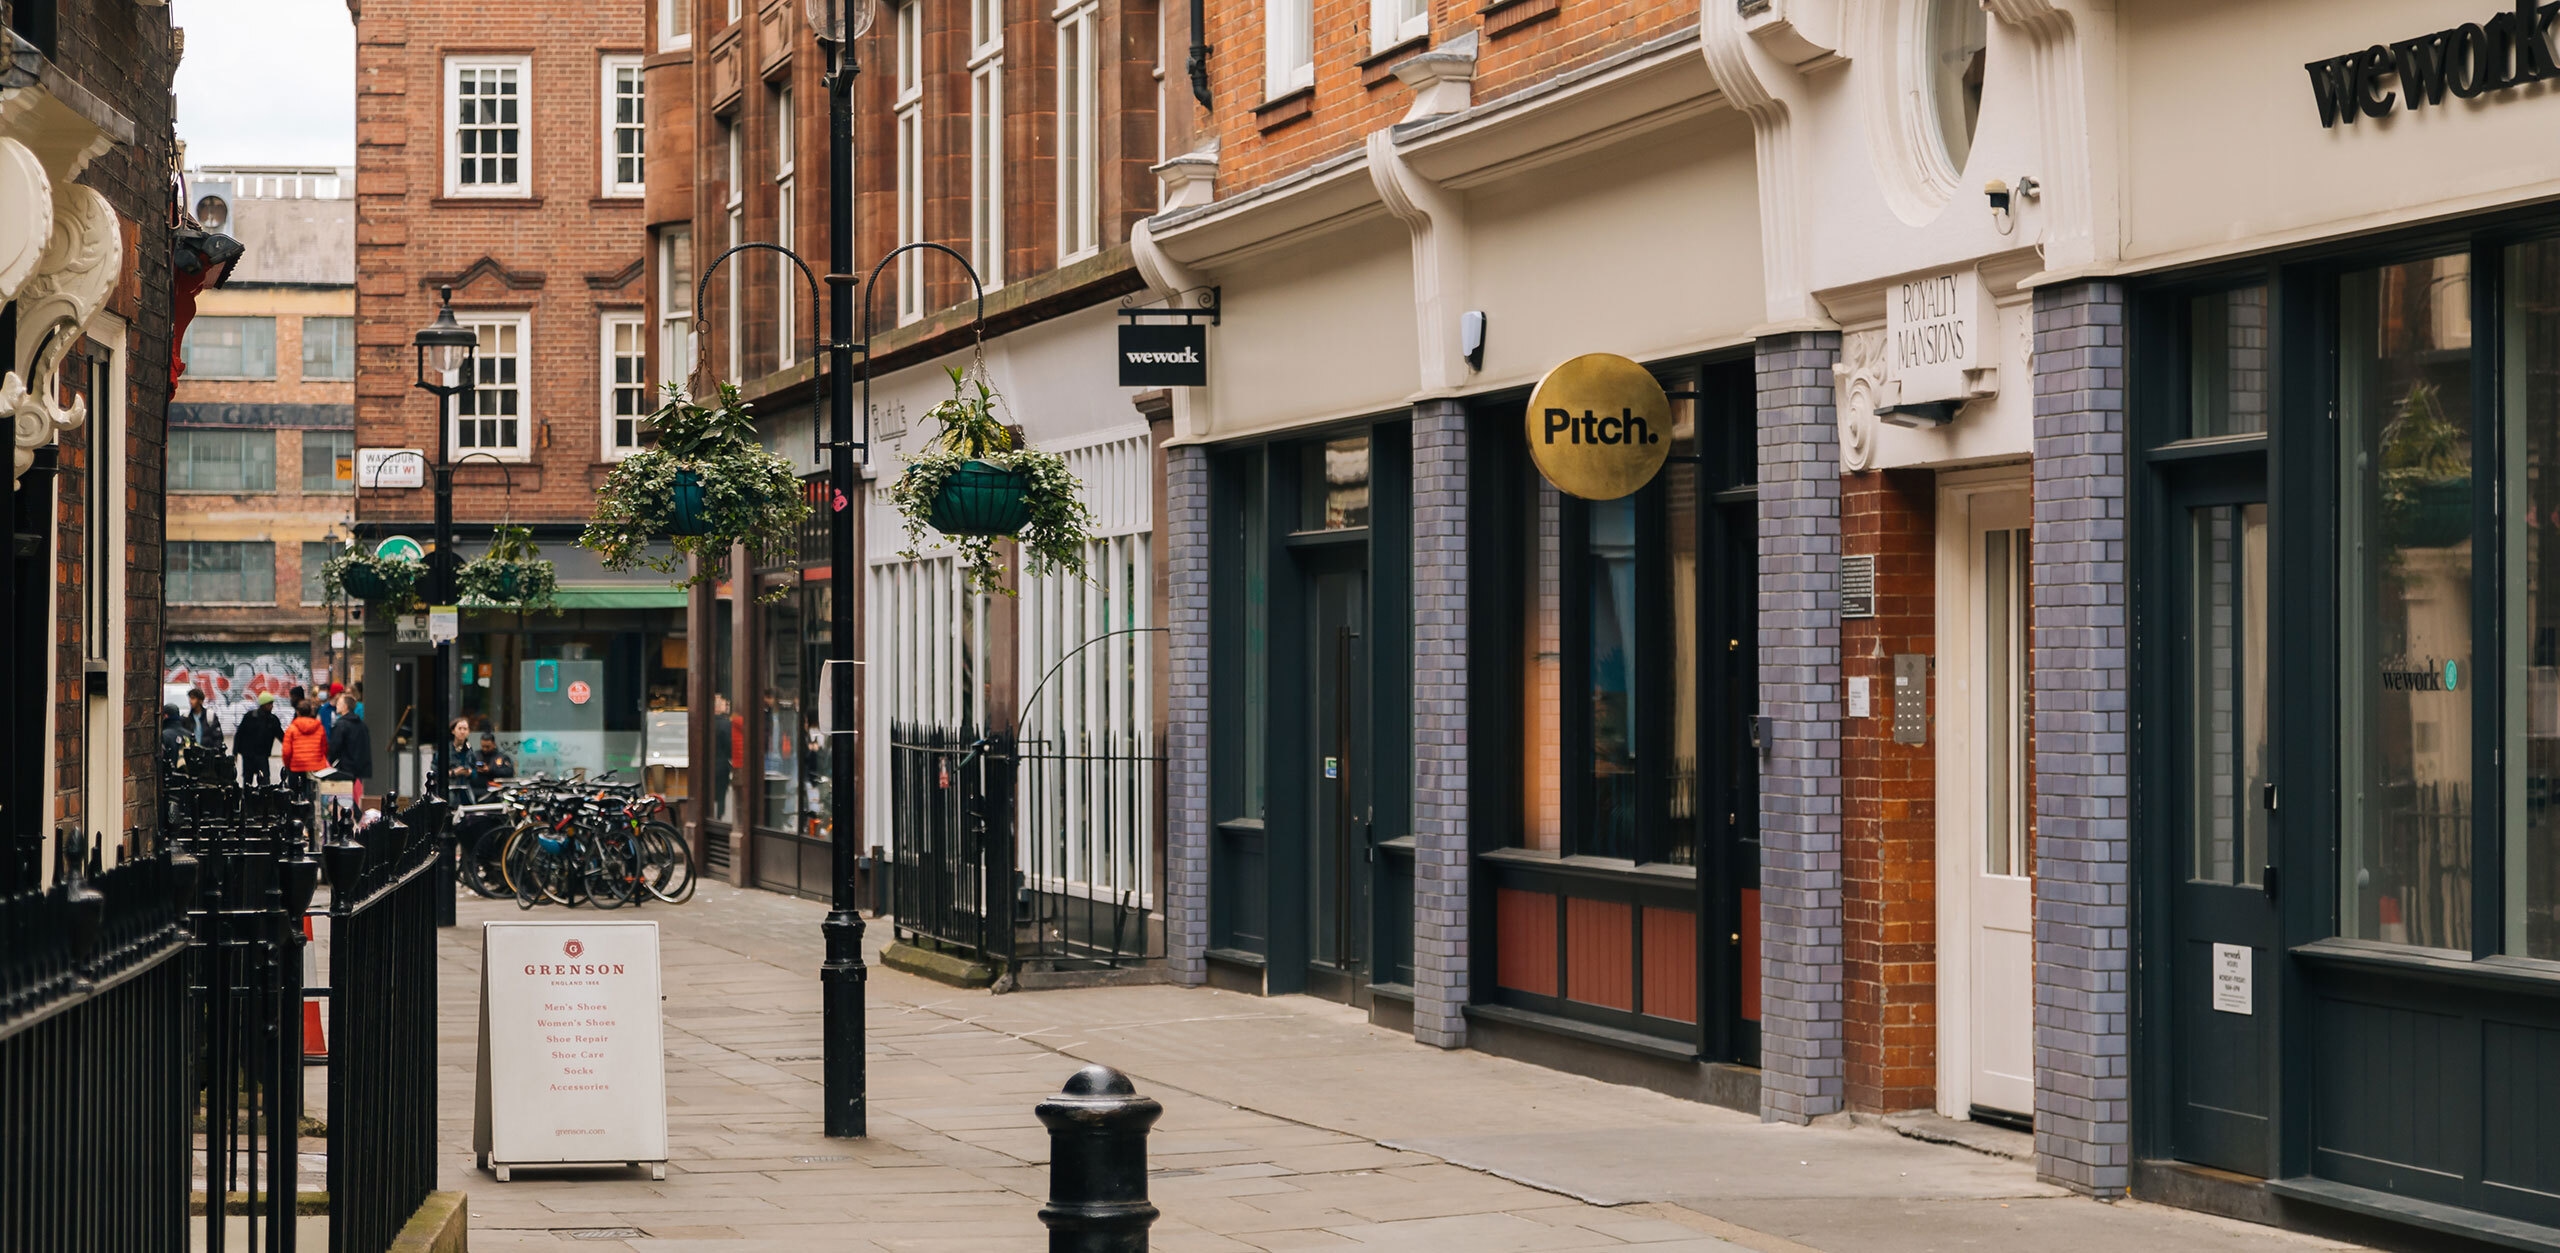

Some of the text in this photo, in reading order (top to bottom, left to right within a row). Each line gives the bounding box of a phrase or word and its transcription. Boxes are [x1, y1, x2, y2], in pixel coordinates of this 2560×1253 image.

[2304, 0, 2560, 128] wework
[1903, 274, 1957, 323] ROYALTY
[1898, 320, 1964, 370] MANSIONS
[1126, 346, 1199, 363] wework
[1544, 408, 1659, 445] Pitch.
[2382, 659, 2440, 691] wework
[524, 964, 625, 975] GRENSON
[544, 1003, 607, 1011] Men's Shoes
[537, 1019, 581, 1027] Women's
[546, 1035, 608, 1044] Shoe Repair
[552, 1051, 605, 1059] Shoe Care
[563, 1067, 594, 1075] Socks
[549, 1083, 609, 1091] Accessories
[555, 1128, 606, 1136] grenson.com
